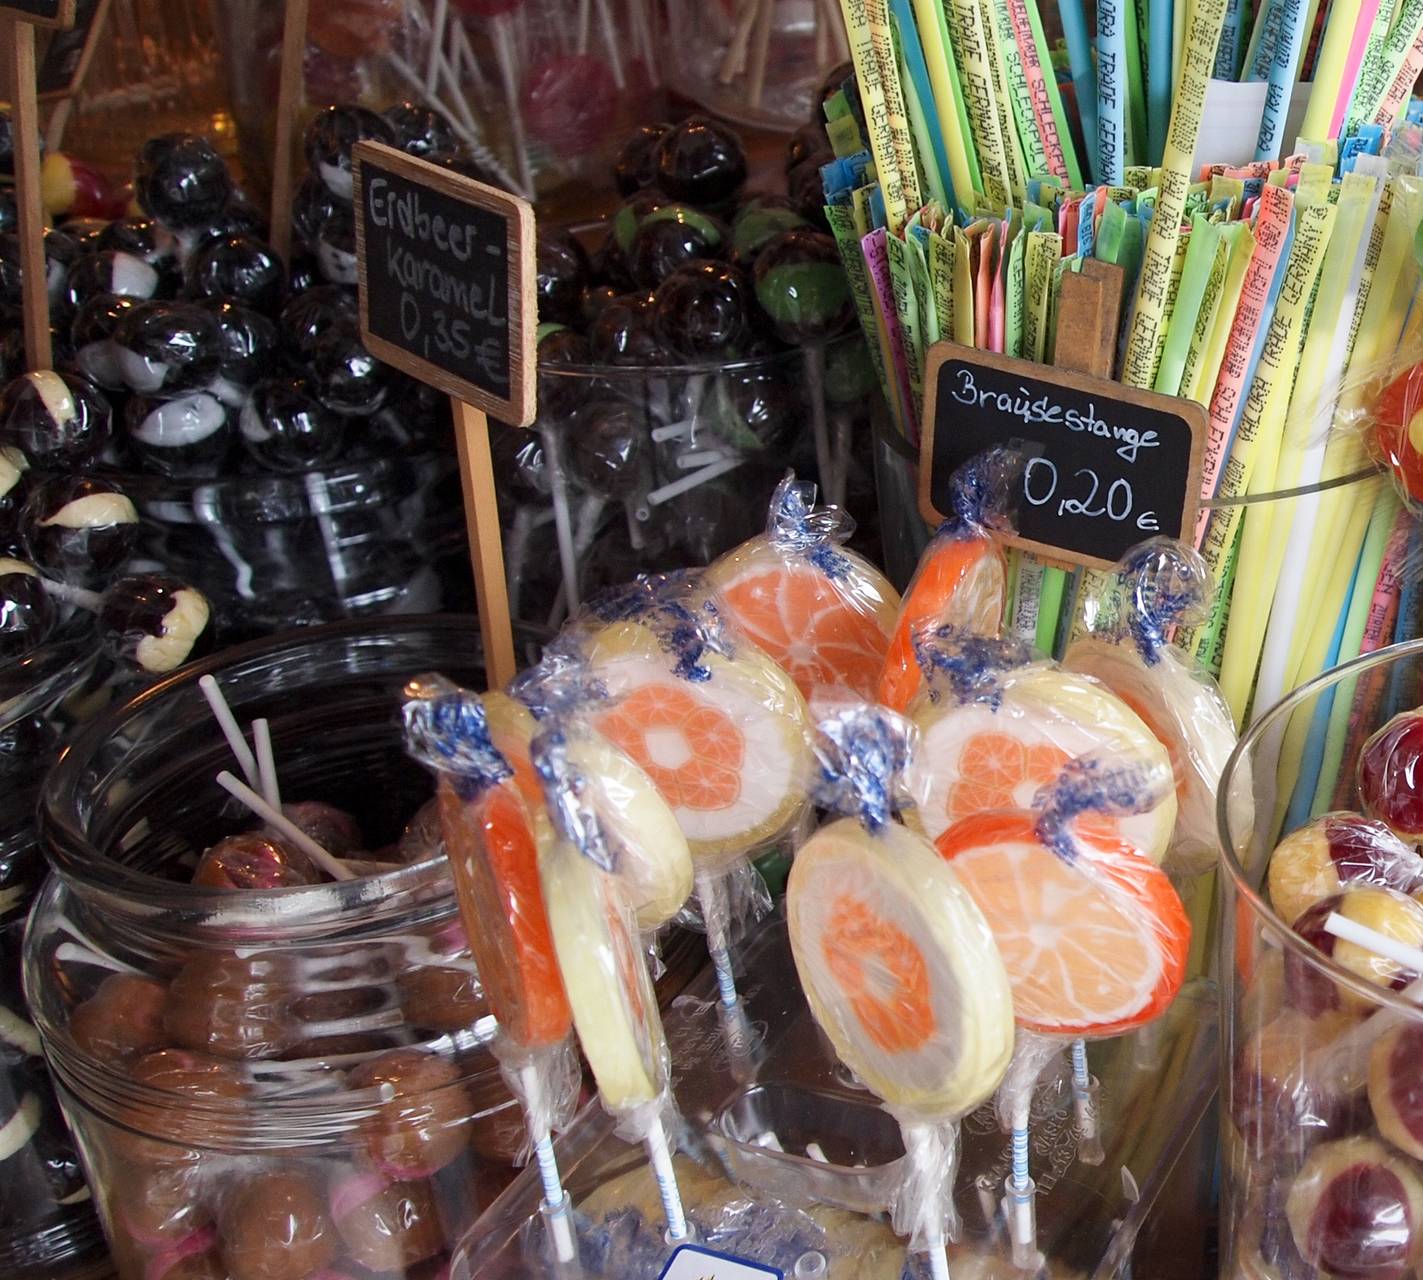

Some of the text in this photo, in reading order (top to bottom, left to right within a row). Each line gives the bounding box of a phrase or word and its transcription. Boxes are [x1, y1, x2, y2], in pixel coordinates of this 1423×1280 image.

[954, 2, 983, 64] TRADE
[1097, 49, 1116, 108] TRADE
[966, 69, 1000, 157] GERMANY
[1098, 116, 1117, 184] GERMAN
[1152, 169, 1188, 240] VALORA
[1140, 248, 1171, 308] TRADE
[1261, 316, 1292, 369] TRADE
